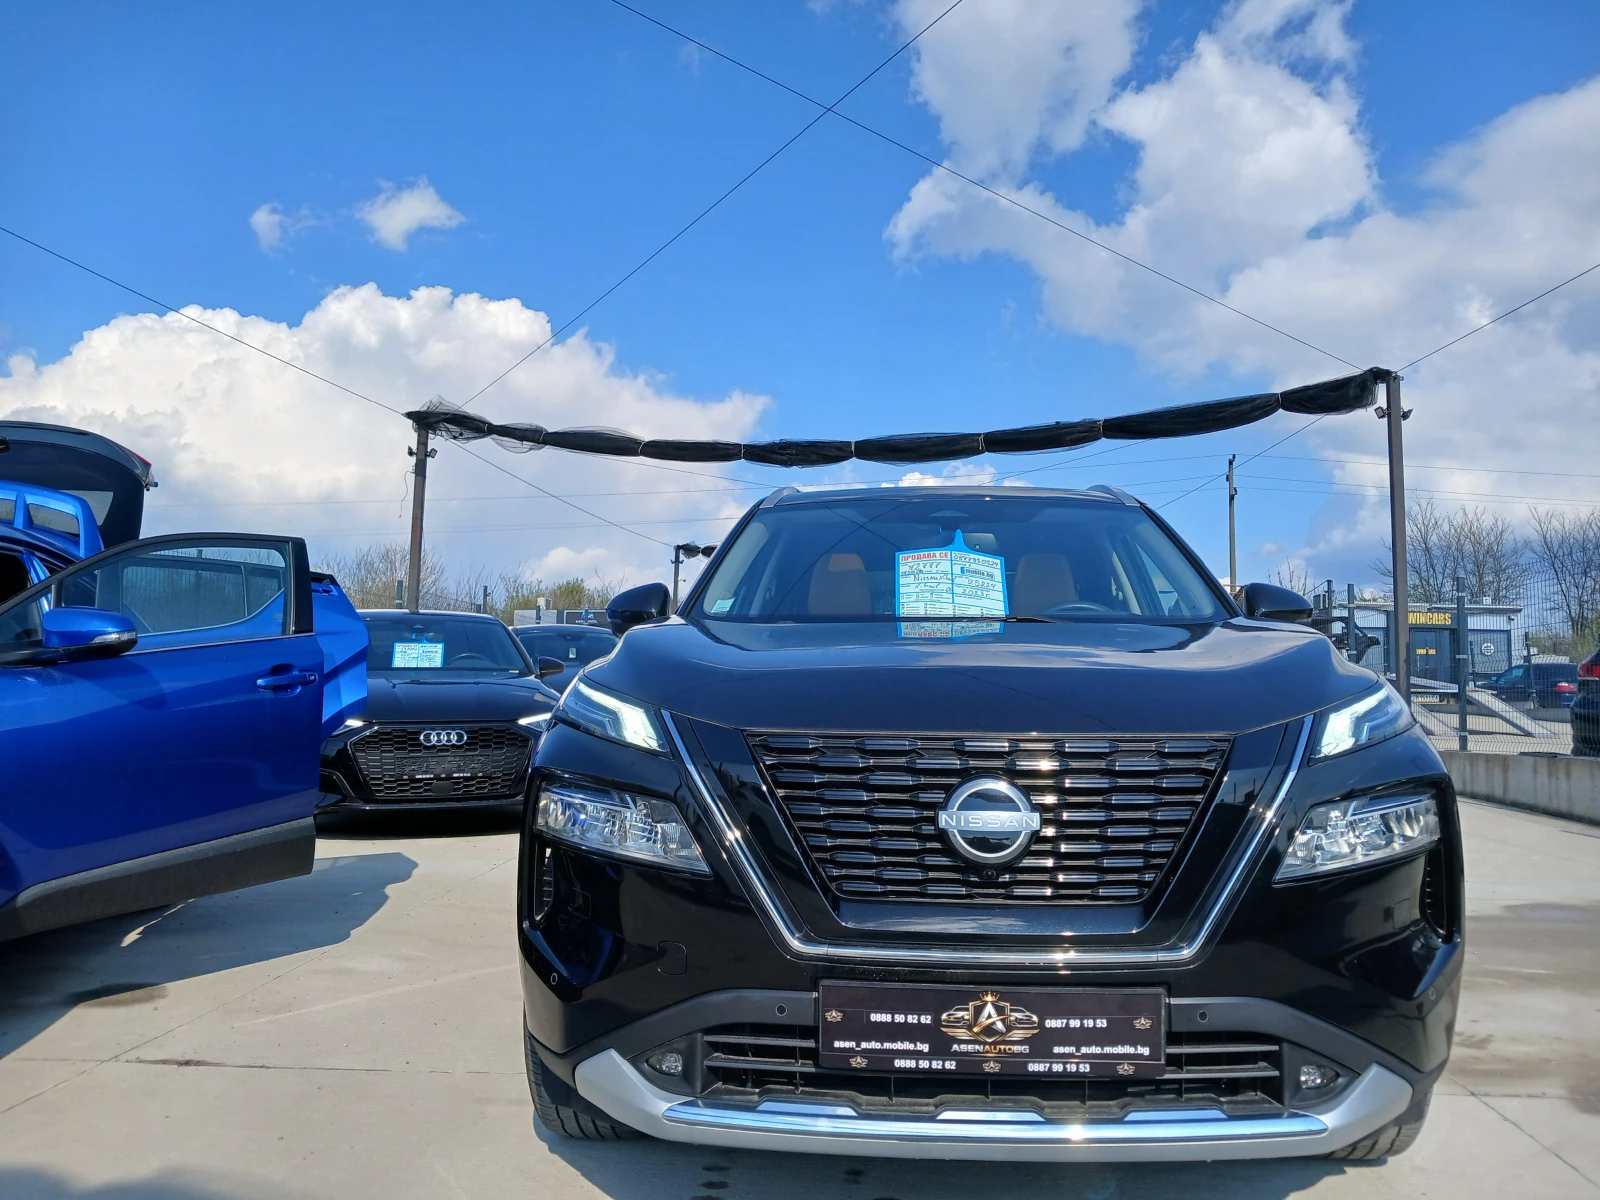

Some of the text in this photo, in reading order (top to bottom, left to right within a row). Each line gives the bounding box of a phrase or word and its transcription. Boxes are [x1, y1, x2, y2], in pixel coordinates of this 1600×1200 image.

[901, 553, 937, 561] ПРОДАВА
[966, 568, 994, 579] mobile.bg
[1408, 612, 1451, 625] WINCARS
[941, 814, 1037, 828] NISSAN
[870, 1013, 932, 1024] 0888 50 82 62
[1045, 1019, 1107, 1028] 0887 99 19 53
[834, 1040, 930, 1052] asen_auto.mobile.bg
[951, 1044, 1030, 1054] ASENAUTOBG
[1053, 1045, 1150, 1056] asen_auto.mobile.bg
[894, 1059, 956, 1069] 0888 50 82 62
[1028, 1063, 1090, 1072] 0887 99 19 53
